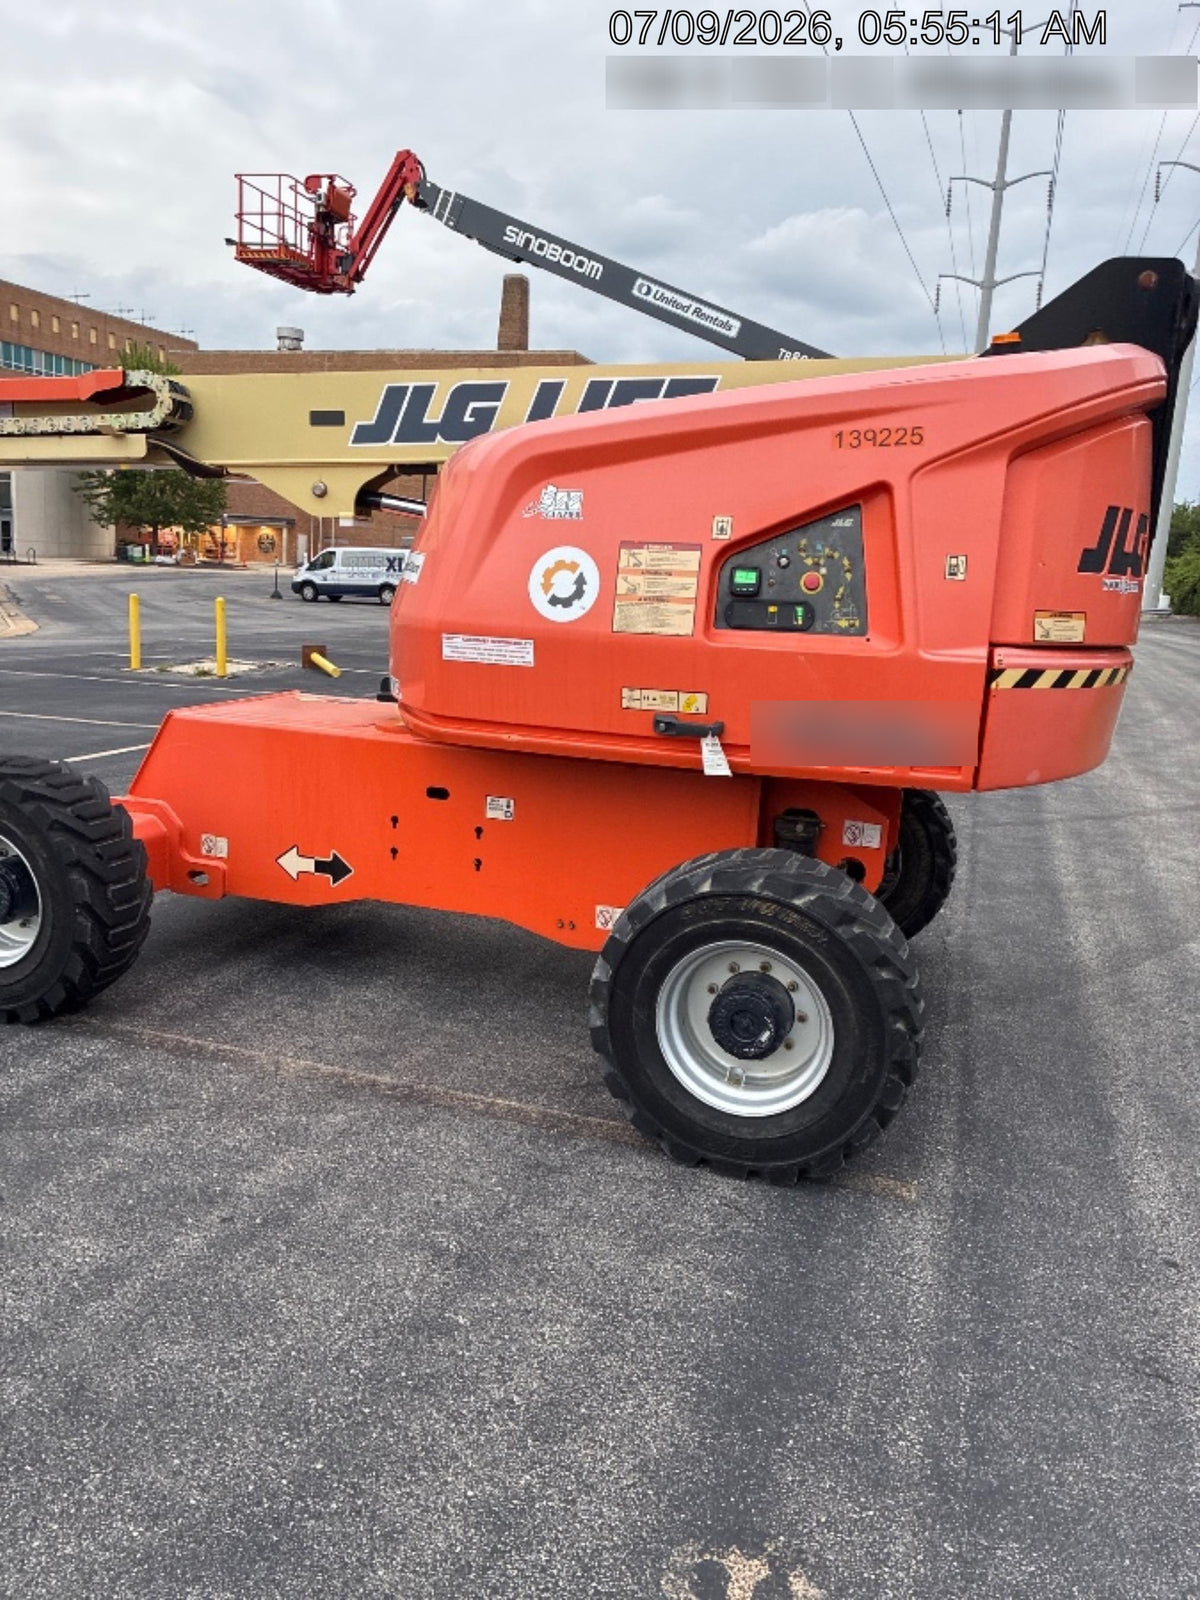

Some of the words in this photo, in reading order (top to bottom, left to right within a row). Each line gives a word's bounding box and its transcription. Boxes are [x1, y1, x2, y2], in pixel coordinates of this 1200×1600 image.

[653, 289, 692, 314] United
[691, 306, 733, 332] Rentals
[348, 380, 510, 446] JLG
[834, 426, 924, 449] 139225
[831, 518, 854, 527] JLG
